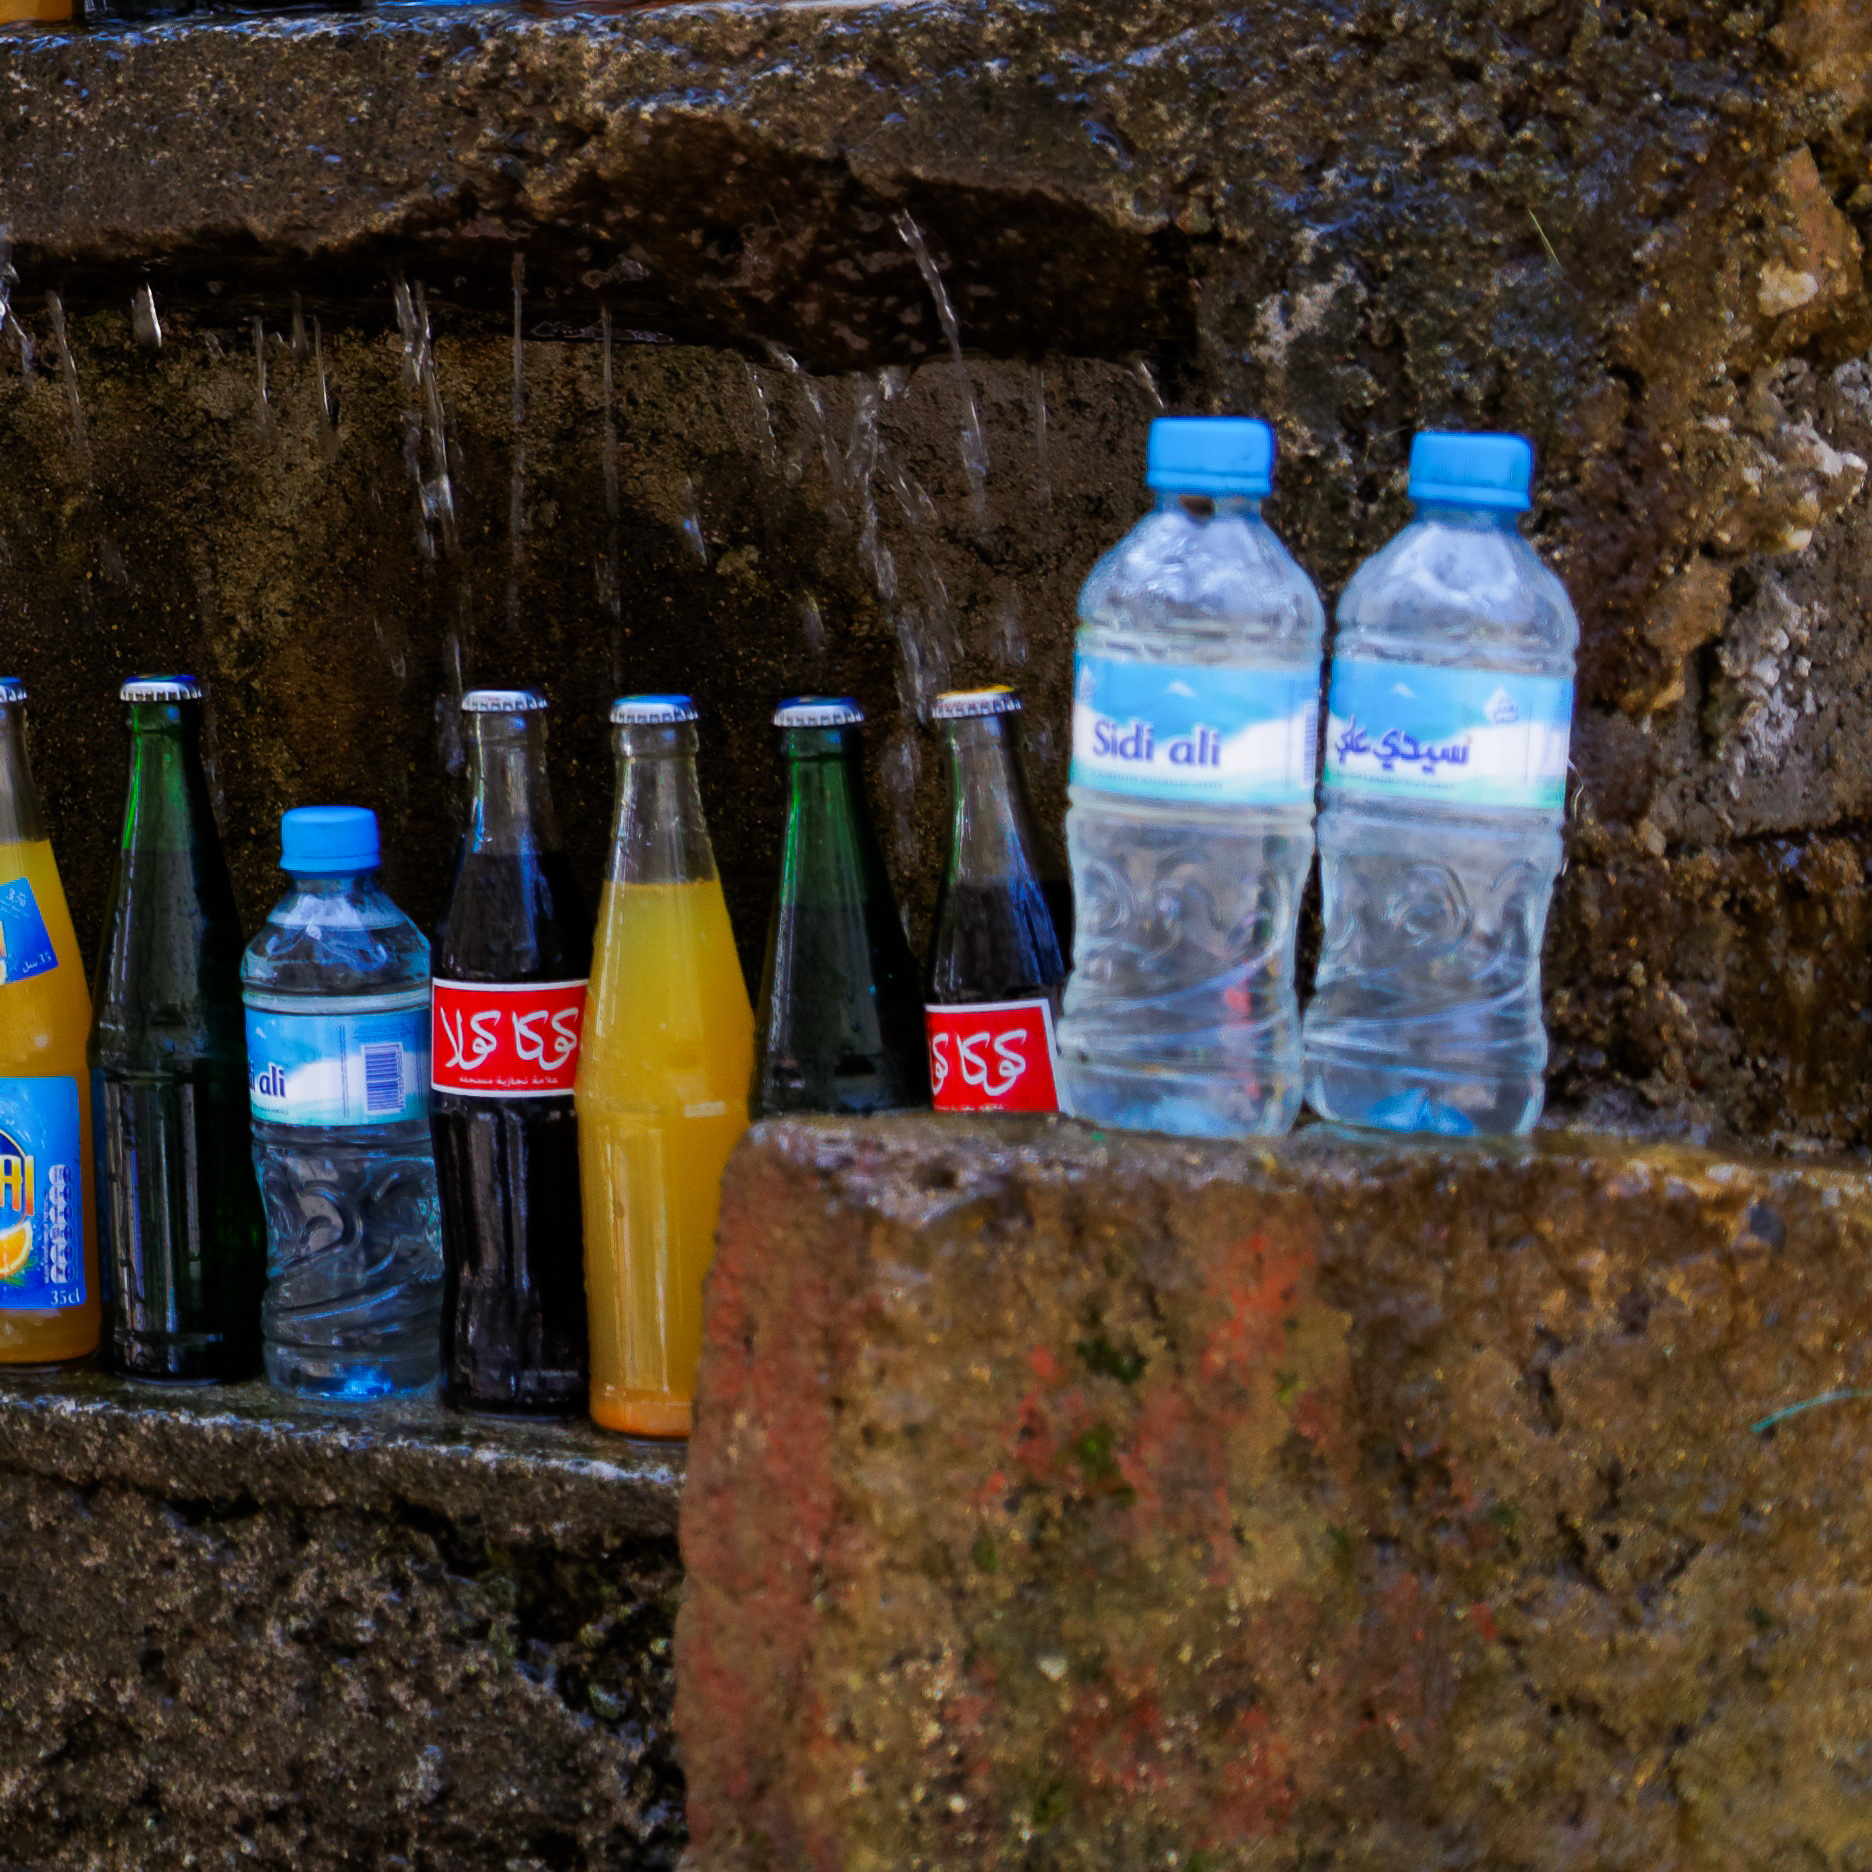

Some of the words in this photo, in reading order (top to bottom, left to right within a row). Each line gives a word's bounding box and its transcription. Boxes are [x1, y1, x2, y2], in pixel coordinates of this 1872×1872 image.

[1092, 719, 1155, 765] Sidi
[1168, 729, 1222, 769] ali
[1372, 728, 1470, 774] سيدي
[440, 1007, 501, 1071] كولا
[511, 1007, 578, 1071] كوكا
[956, 1029, 1027, 1097] كوكا
[258, 1062, 287, 1100] ali
[50, 1287, 81, 1306] 35cl
